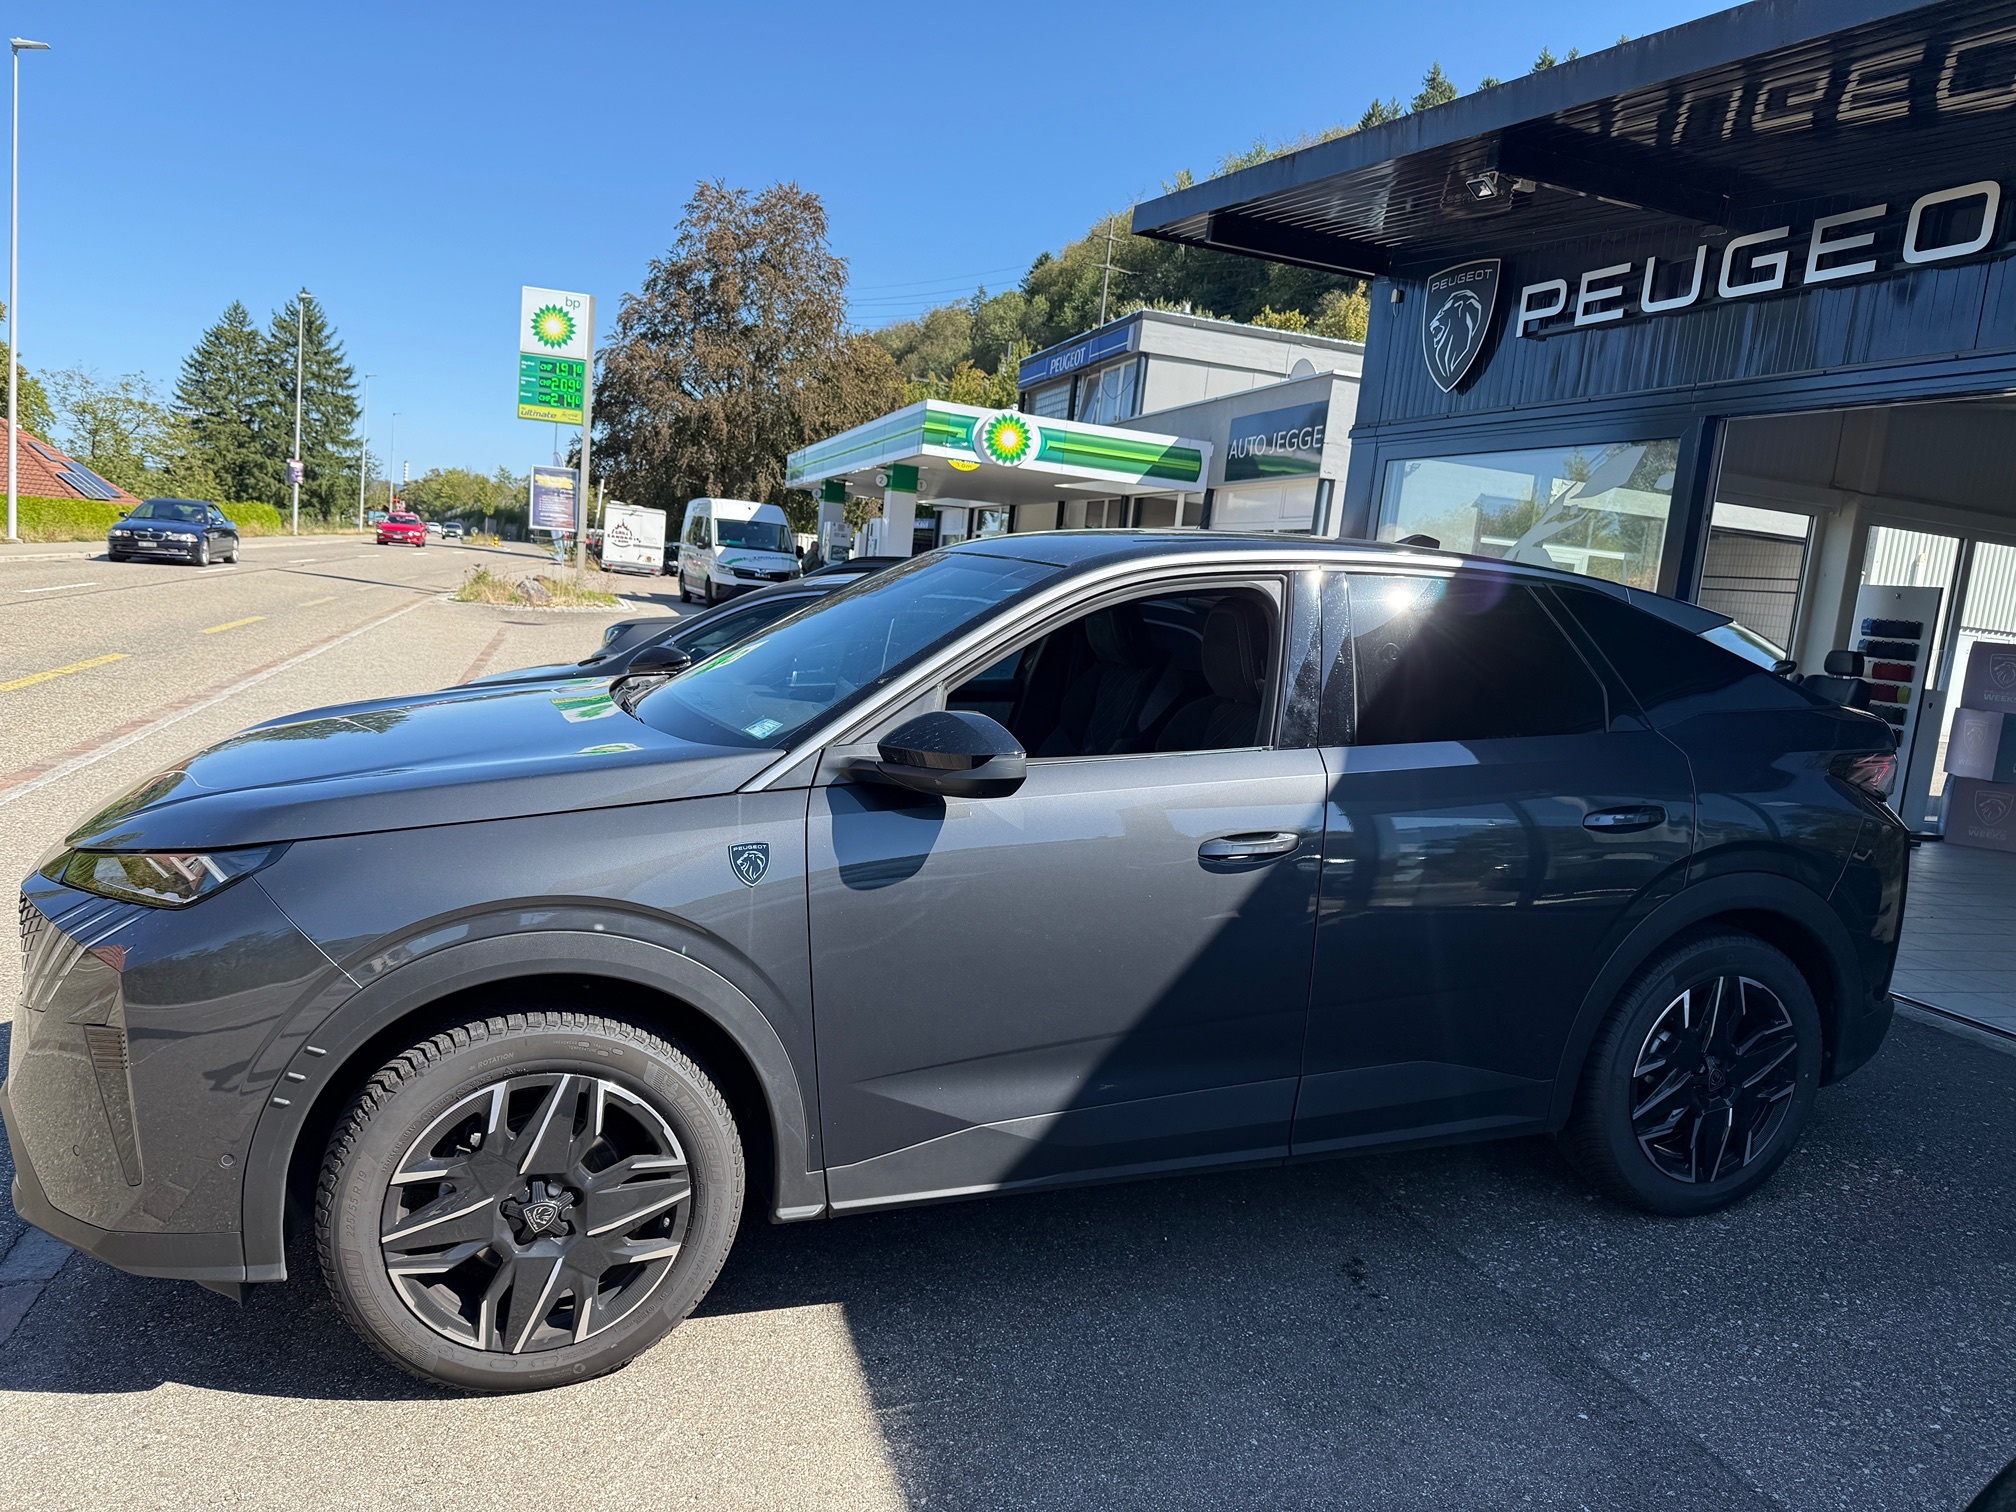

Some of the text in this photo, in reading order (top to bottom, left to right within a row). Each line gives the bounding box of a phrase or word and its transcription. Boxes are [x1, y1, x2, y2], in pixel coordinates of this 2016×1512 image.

[1515, 180, 2001, 338] PEUGEO
[1430, 268, 1493, 294] PEUGEOT
[565, 296, 581, 310] bp
[1050, 346, 1086, 375] PEUGEOT
[1228, 424, 1324, 460] AUTO JEGGE
[878, 476, 884, 485] 2
[733, 844, 767, 852] PEUGEOT
[1968, 829, 2007, 841] WEEKS
[477, 1052, 515, 1069] ROTATION
[677, 1094, 723, 1181] MICHELIN
[346, 1170, 367, 1239] 225/55 R 19
[344, 1253, 401, 1344] MICHELIN
